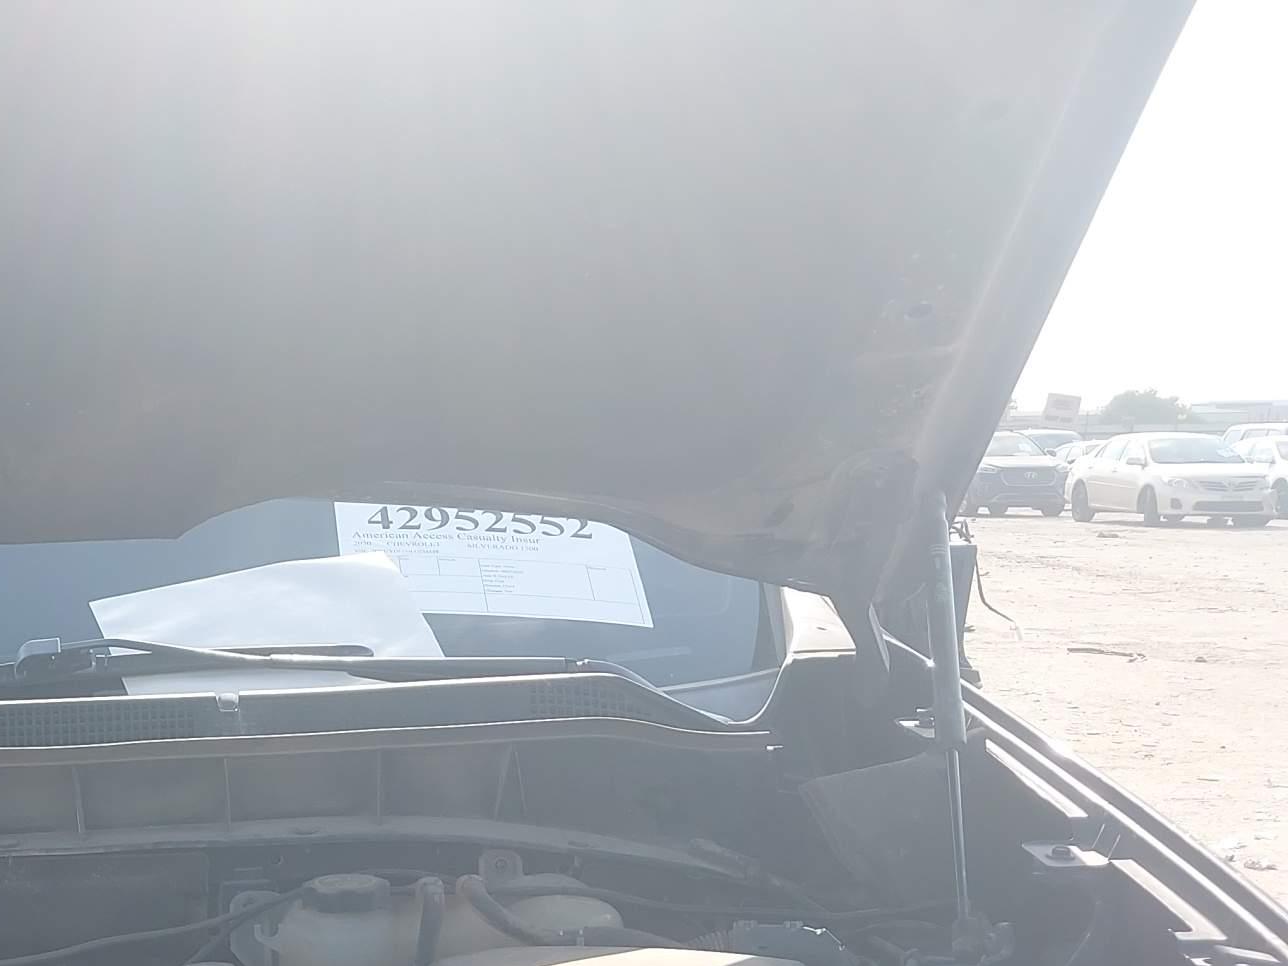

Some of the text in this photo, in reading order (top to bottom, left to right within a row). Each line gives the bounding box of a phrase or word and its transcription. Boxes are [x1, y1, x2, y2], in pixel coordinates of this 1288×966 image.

[367, 506, 593, 540] 42952552
[353, 531, 540, 545] American Access Casualty Insur
